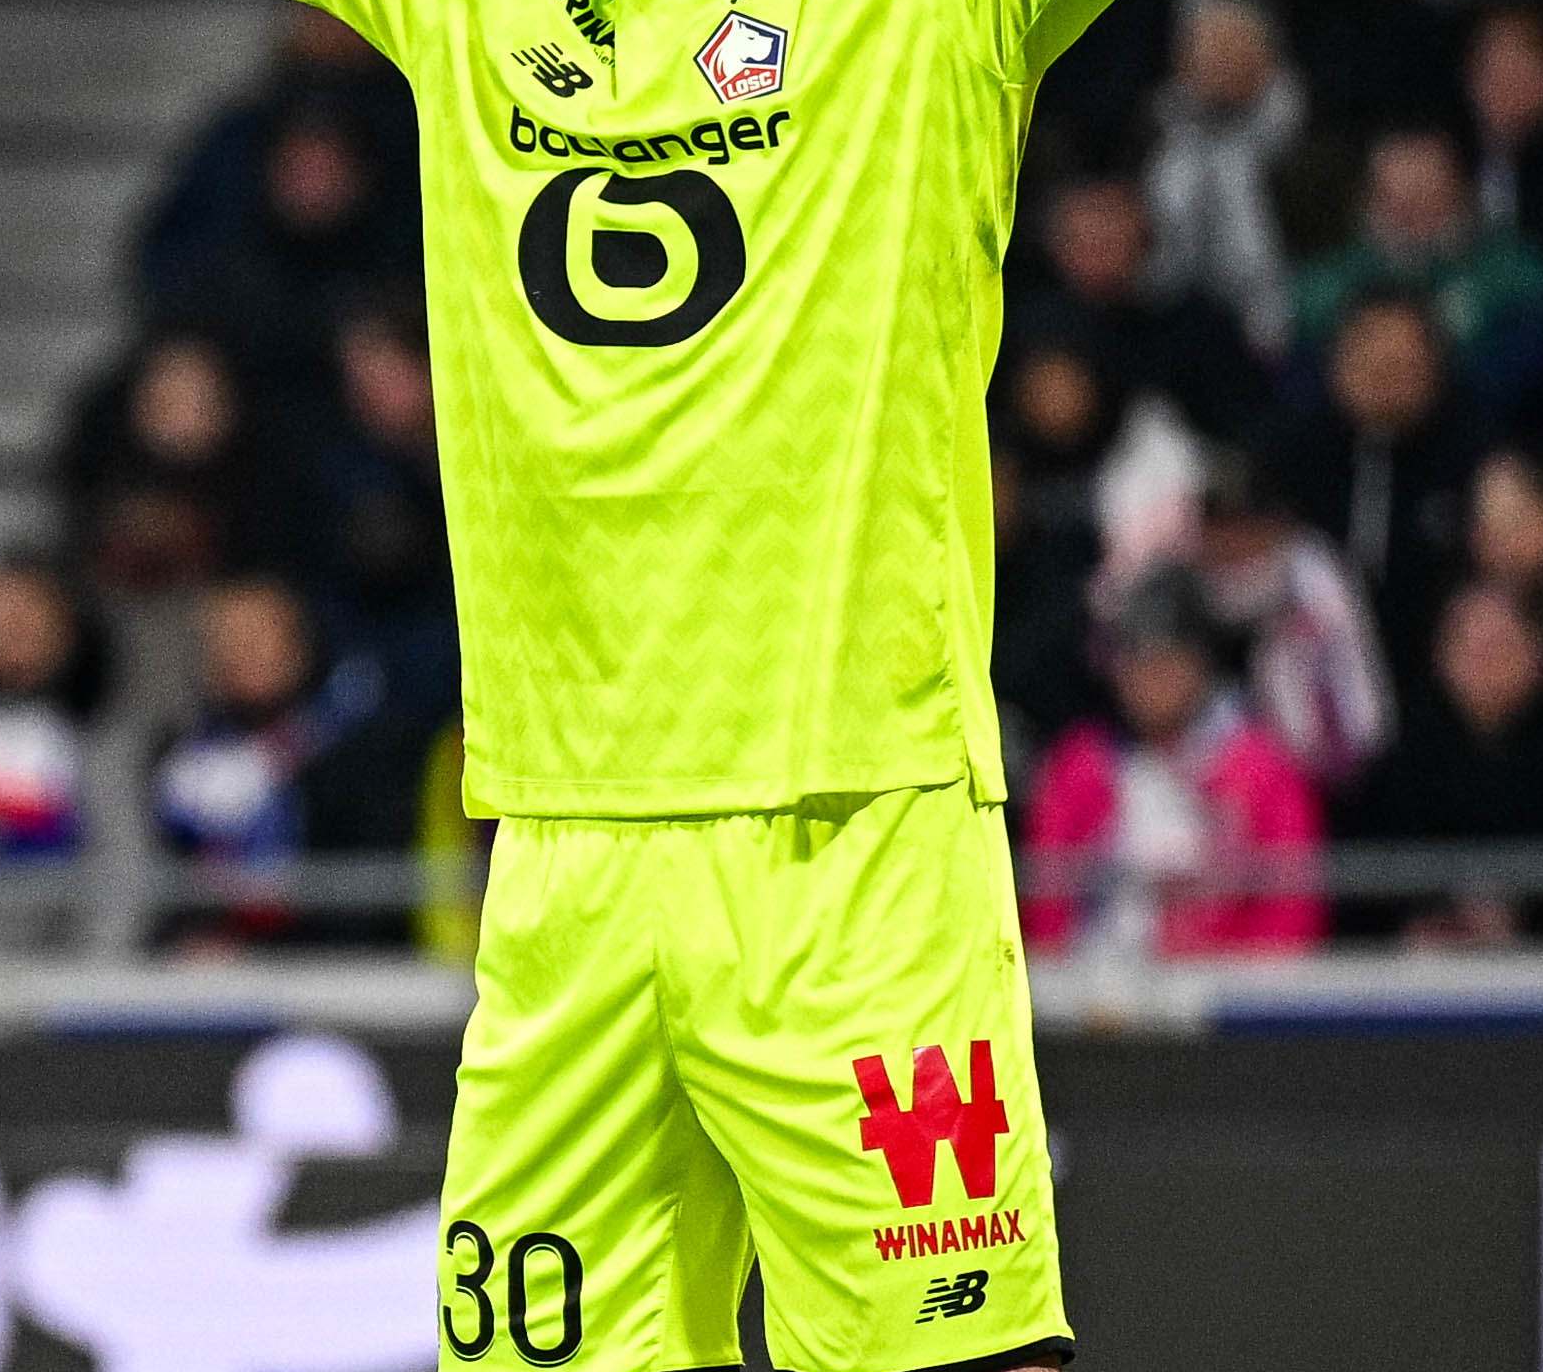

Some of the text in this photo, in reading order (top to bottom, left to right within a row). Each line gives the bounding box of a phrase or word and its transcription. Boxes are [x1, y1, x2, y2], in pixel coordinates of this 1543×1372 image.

[725, 70, 774, 99] LOSC
[872, 1208, 1027, 1262] WINAMAX
[442, 1219, 585, 1369] 30
